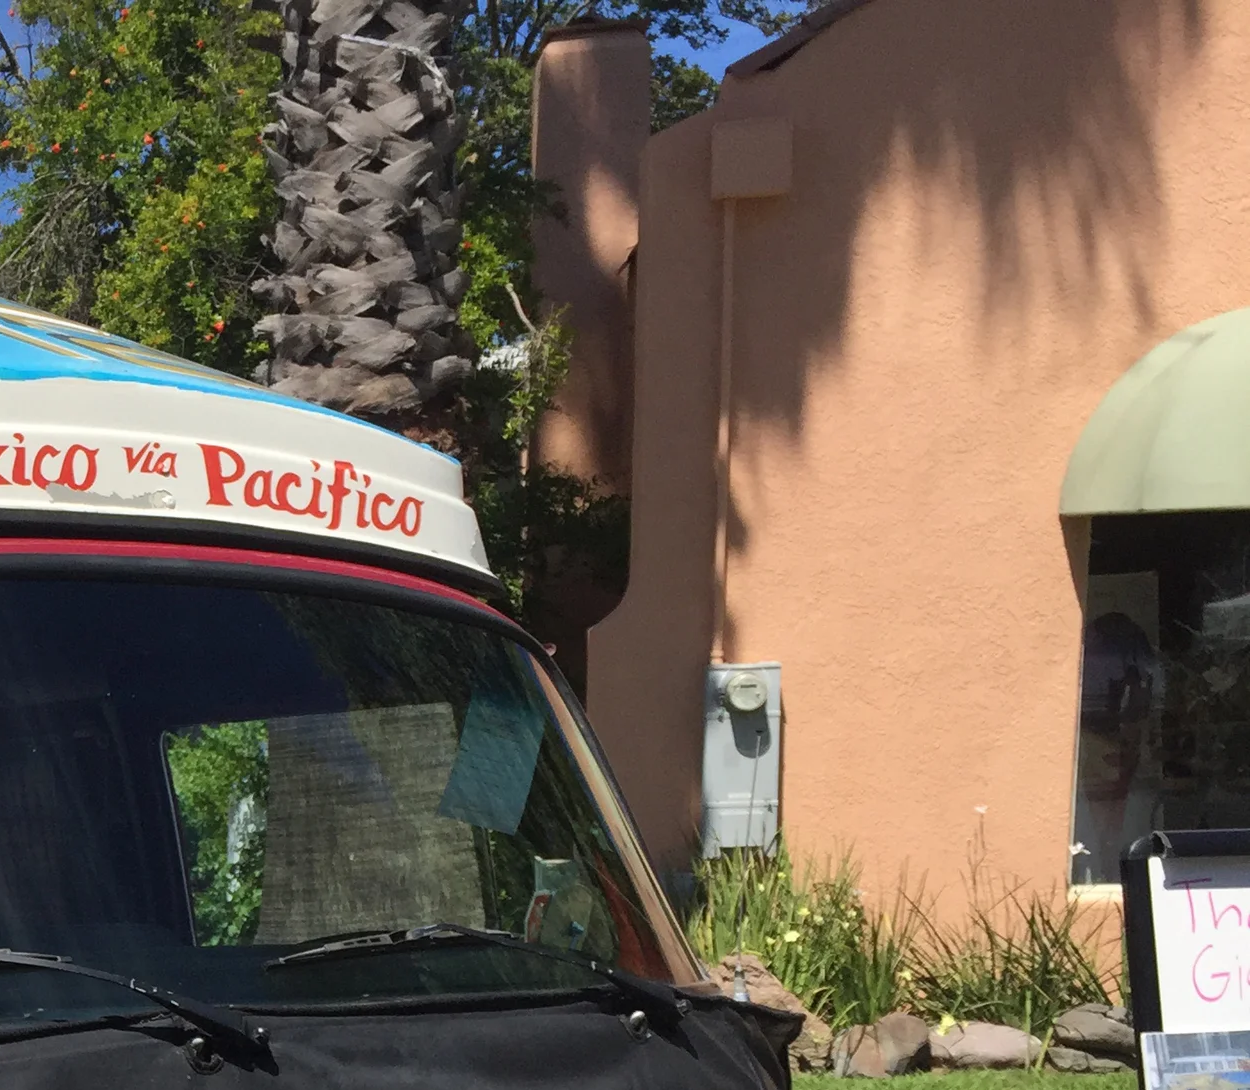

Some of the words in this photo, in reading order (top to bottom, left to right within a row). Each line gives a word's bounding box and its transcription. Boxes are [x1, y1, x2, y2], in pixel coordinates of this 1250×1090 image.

[196, 443, 424, 538] Pacifico
[1172, 877, 1250, 933] Th
[1192, 944, 1250, 1003] Gi
